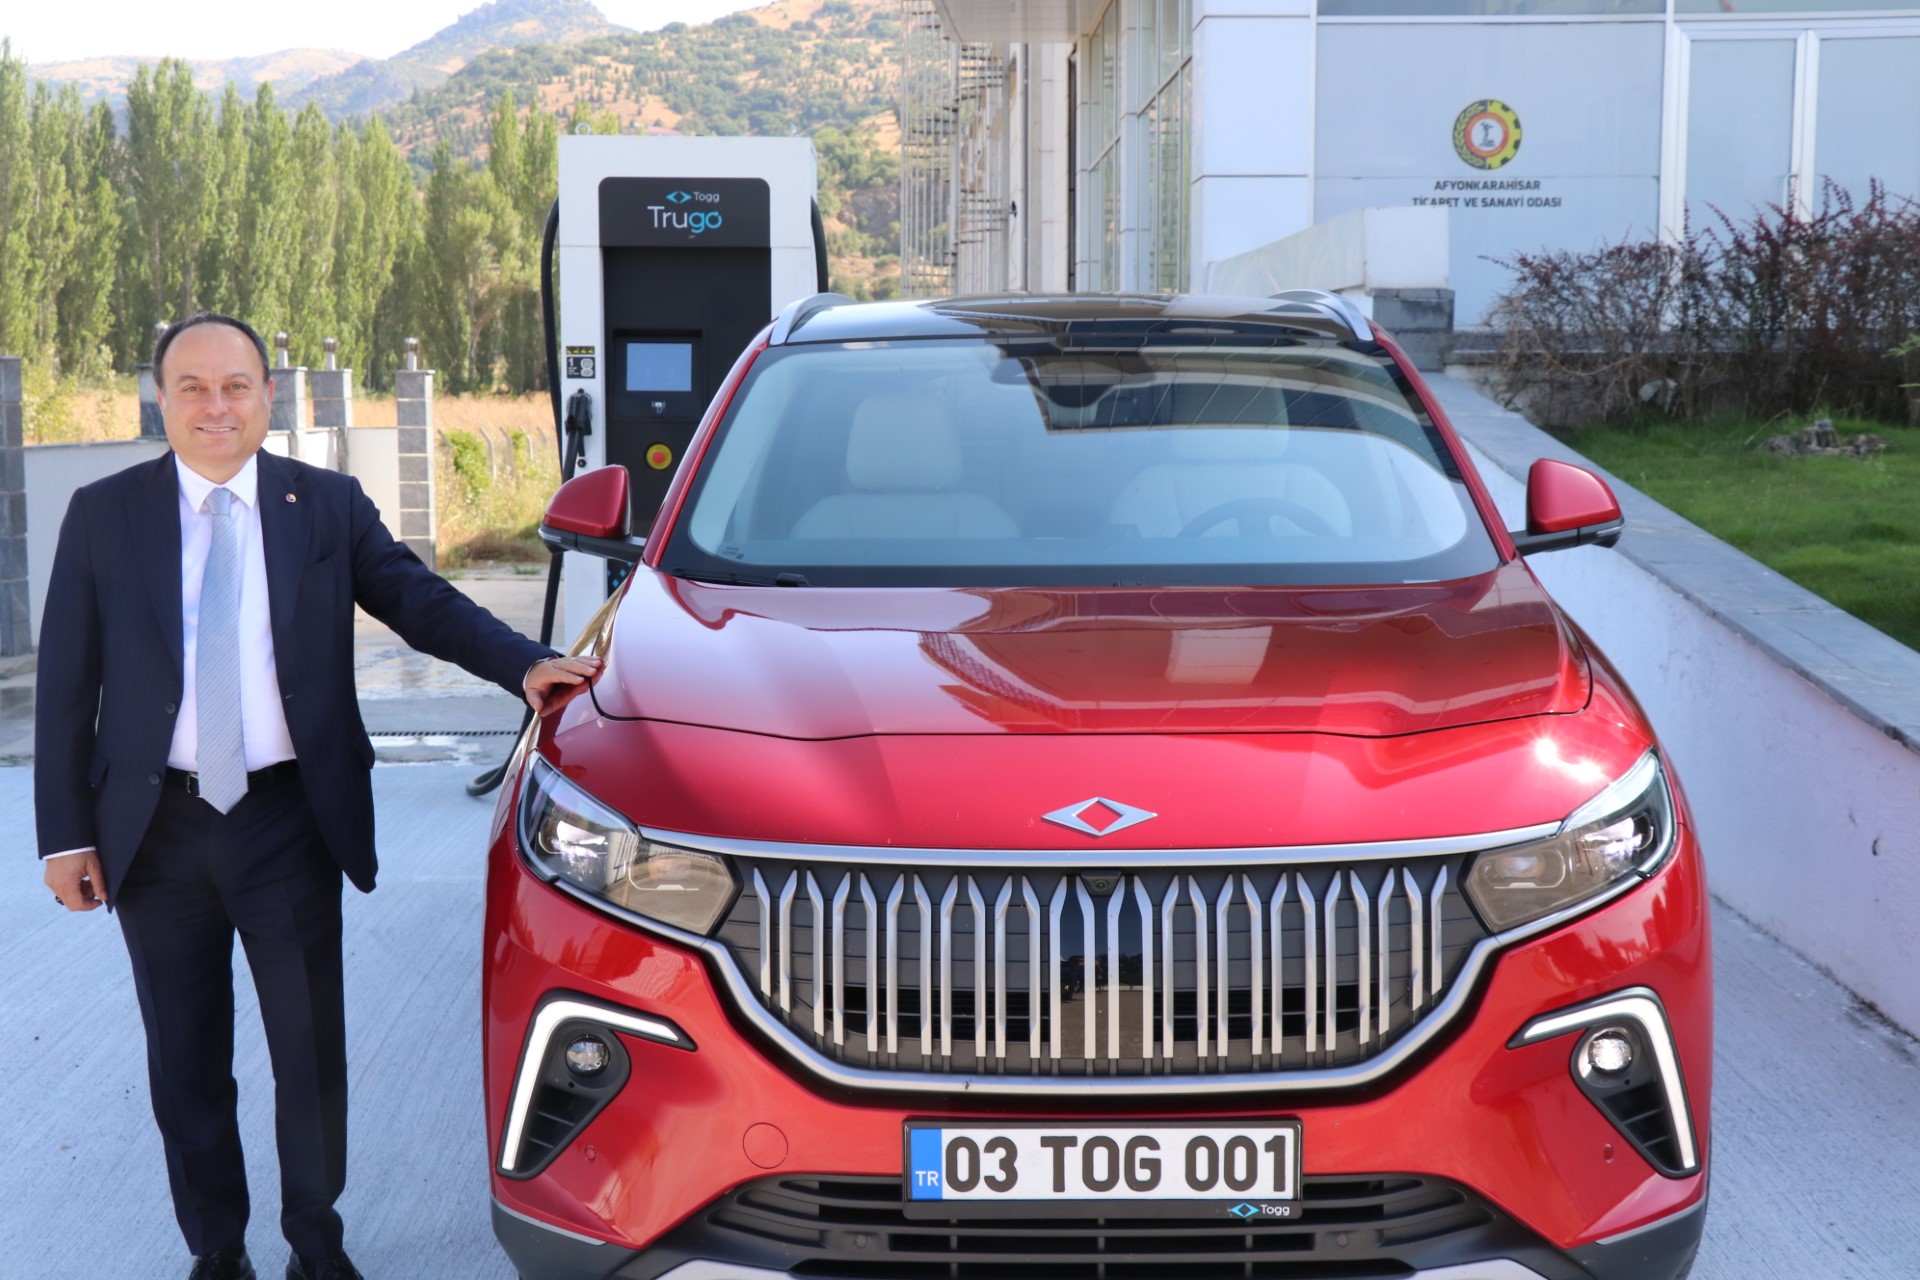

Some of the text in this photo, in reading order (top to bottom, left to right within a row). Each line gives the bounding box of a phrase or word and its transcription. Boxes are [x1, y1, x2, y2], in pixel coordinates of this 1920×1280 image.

[1434, 178, 1541, 191] AFYONKARAHİSAR
[693, 191, 720, 203] Togg
[1464, 197, 1478, 208] VE
[1481, 195, 1524, 208] SANAYİ
[1527, 197, 1562, 208] ODASI
[647, 205, 722, 233] Trugo
[915, 1135, 1286, 1193] TR 03 TOG 001
[1260, 1204, 1290, 1216] Togg
